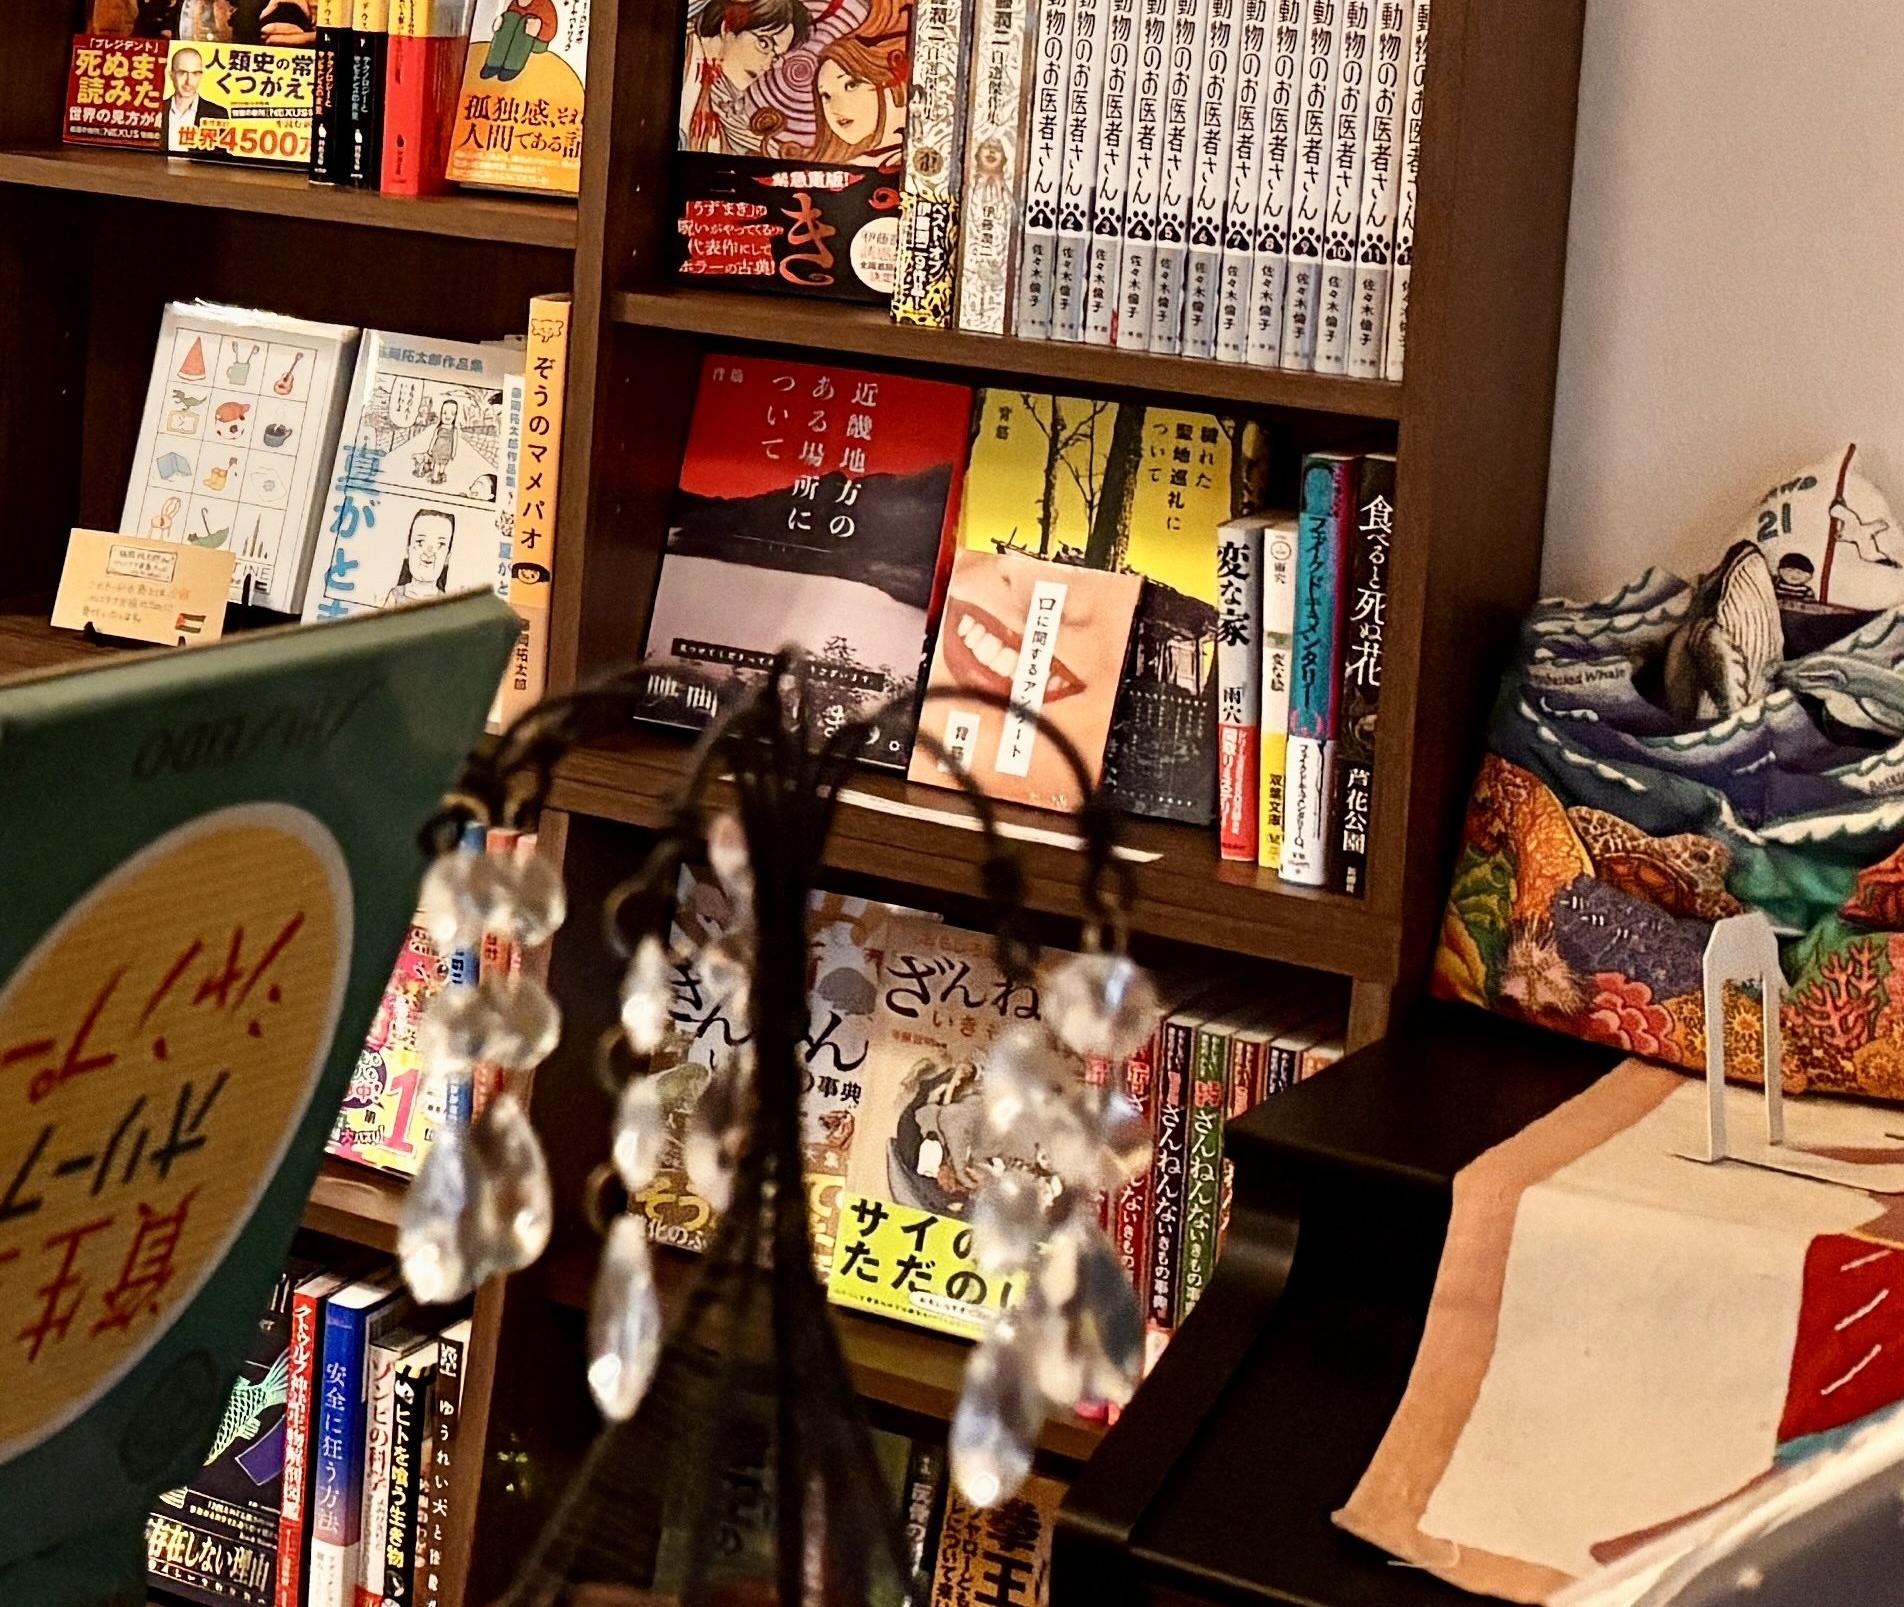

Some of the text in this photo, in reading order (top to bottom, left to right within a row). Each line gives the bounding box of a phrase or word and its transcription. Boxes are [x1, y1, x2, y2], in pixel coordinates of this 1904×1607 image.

[75, 48, 167, 81] 死ぬま
[88, 37, 160, 54] 「プレジデント」
[205, 48, 315, 77] 人類史の常
[69, 106, 162, 129] 世界の見方が
[77, 75, 161, 109] 読みた
[1331, 0, 1368, 226] 動物のお医者さん
[1366, 1, 1403, 229] 動物のお医者さん
[684, 200, 768, 218] 「うずまき」の
[678, 258, 776, 276] ホラーの古典!
[688, 239, 773, 257] 代表作にして
[1091, 247, 1107, 313] 佐々木倫子
[1157, 258, 1172, 323] 佐々木倫子
[1223, 264, 1240, 331] 佐々木倫子
[1292, 272, 1309, 340] 佐々木倫子
[1360, 278, 1377, 346] 佐々木倫子
[761, 375, 796, 460] ついて
[519, 356, 555, 551] ぞうのマメパオ
[787, 375, 835, 531] ある場所に
[829, 382, 879, 538] 近畿地方の
[1148, 423, 1169, 484] ついて
[1166, 422, 1194, 531] 聖地巡礼に
[1194, 425, 1219, 490] 穢れた
[1757, 502, 1792, 543] 21
[1216, 541, 1251, 648] 変な家
[1348, 493, 1394, 688] 食べると死ぬ花
[1222, 685, 1243, 725] 雨穴
[1585, 666, 1626, 684] Whale
[1267, 773, 1283, 827] 双葉文庫
[1341, 768, 1371, 855] 芦花公園
[318, 1361, 347, 1535] 安全に狂う方法
[386, 1405, 412, 1569] ヒトを喰う生き物
